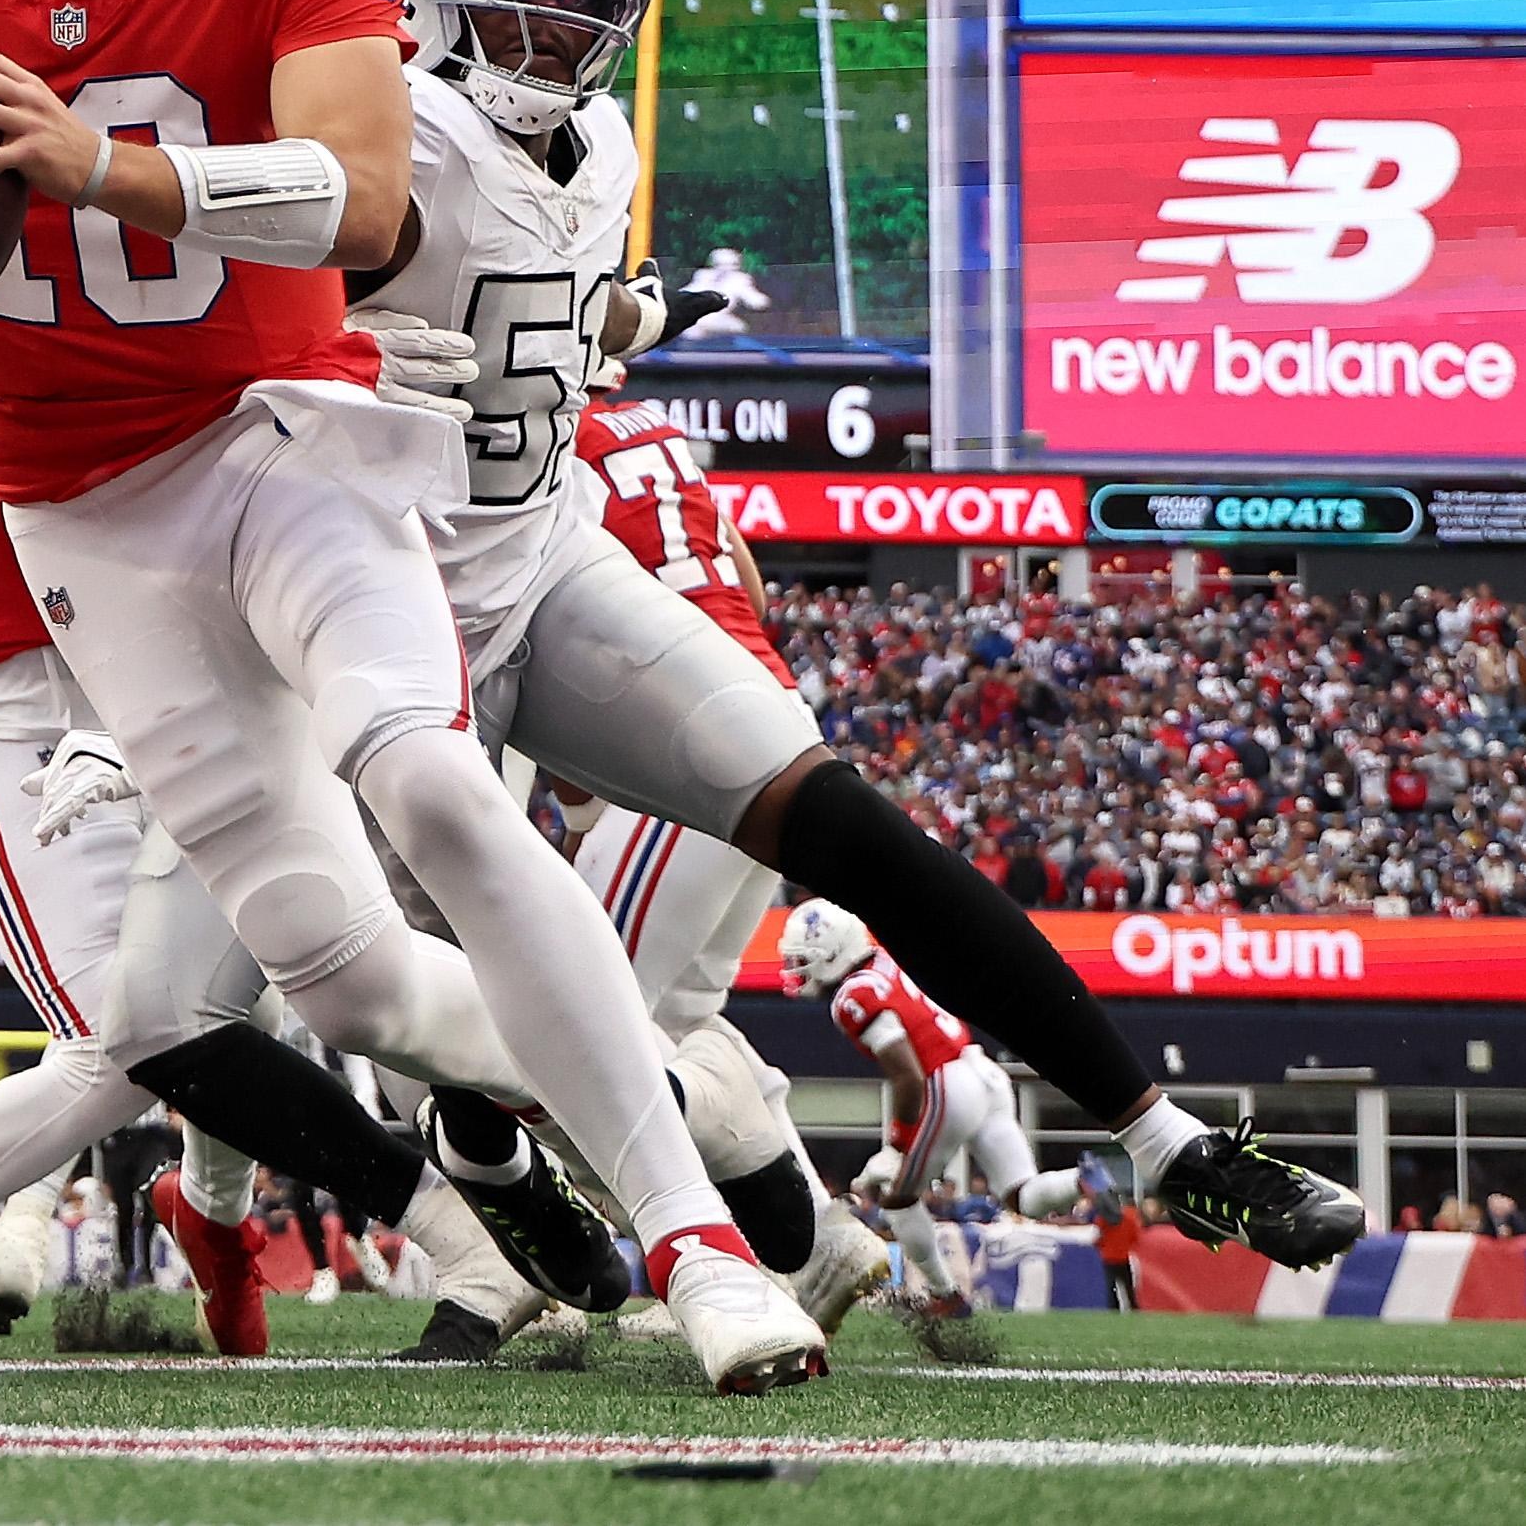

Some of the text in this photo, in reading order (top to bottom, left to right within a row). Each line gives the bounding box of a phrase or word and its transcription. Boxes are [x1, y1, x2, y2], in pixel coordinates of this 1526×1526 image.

[55, 24, 81, 41] NFL
[451, 272, 614, 505] 5
[1051, 325, 1517, 398] new balance
[648, 385, 876, 458] ALL ON 6
[825, 484, 1072, 539] TOYOTA
[1215, 496, 1366, 530] GOPATS
[1112, 913, 1365, 994] Optum
